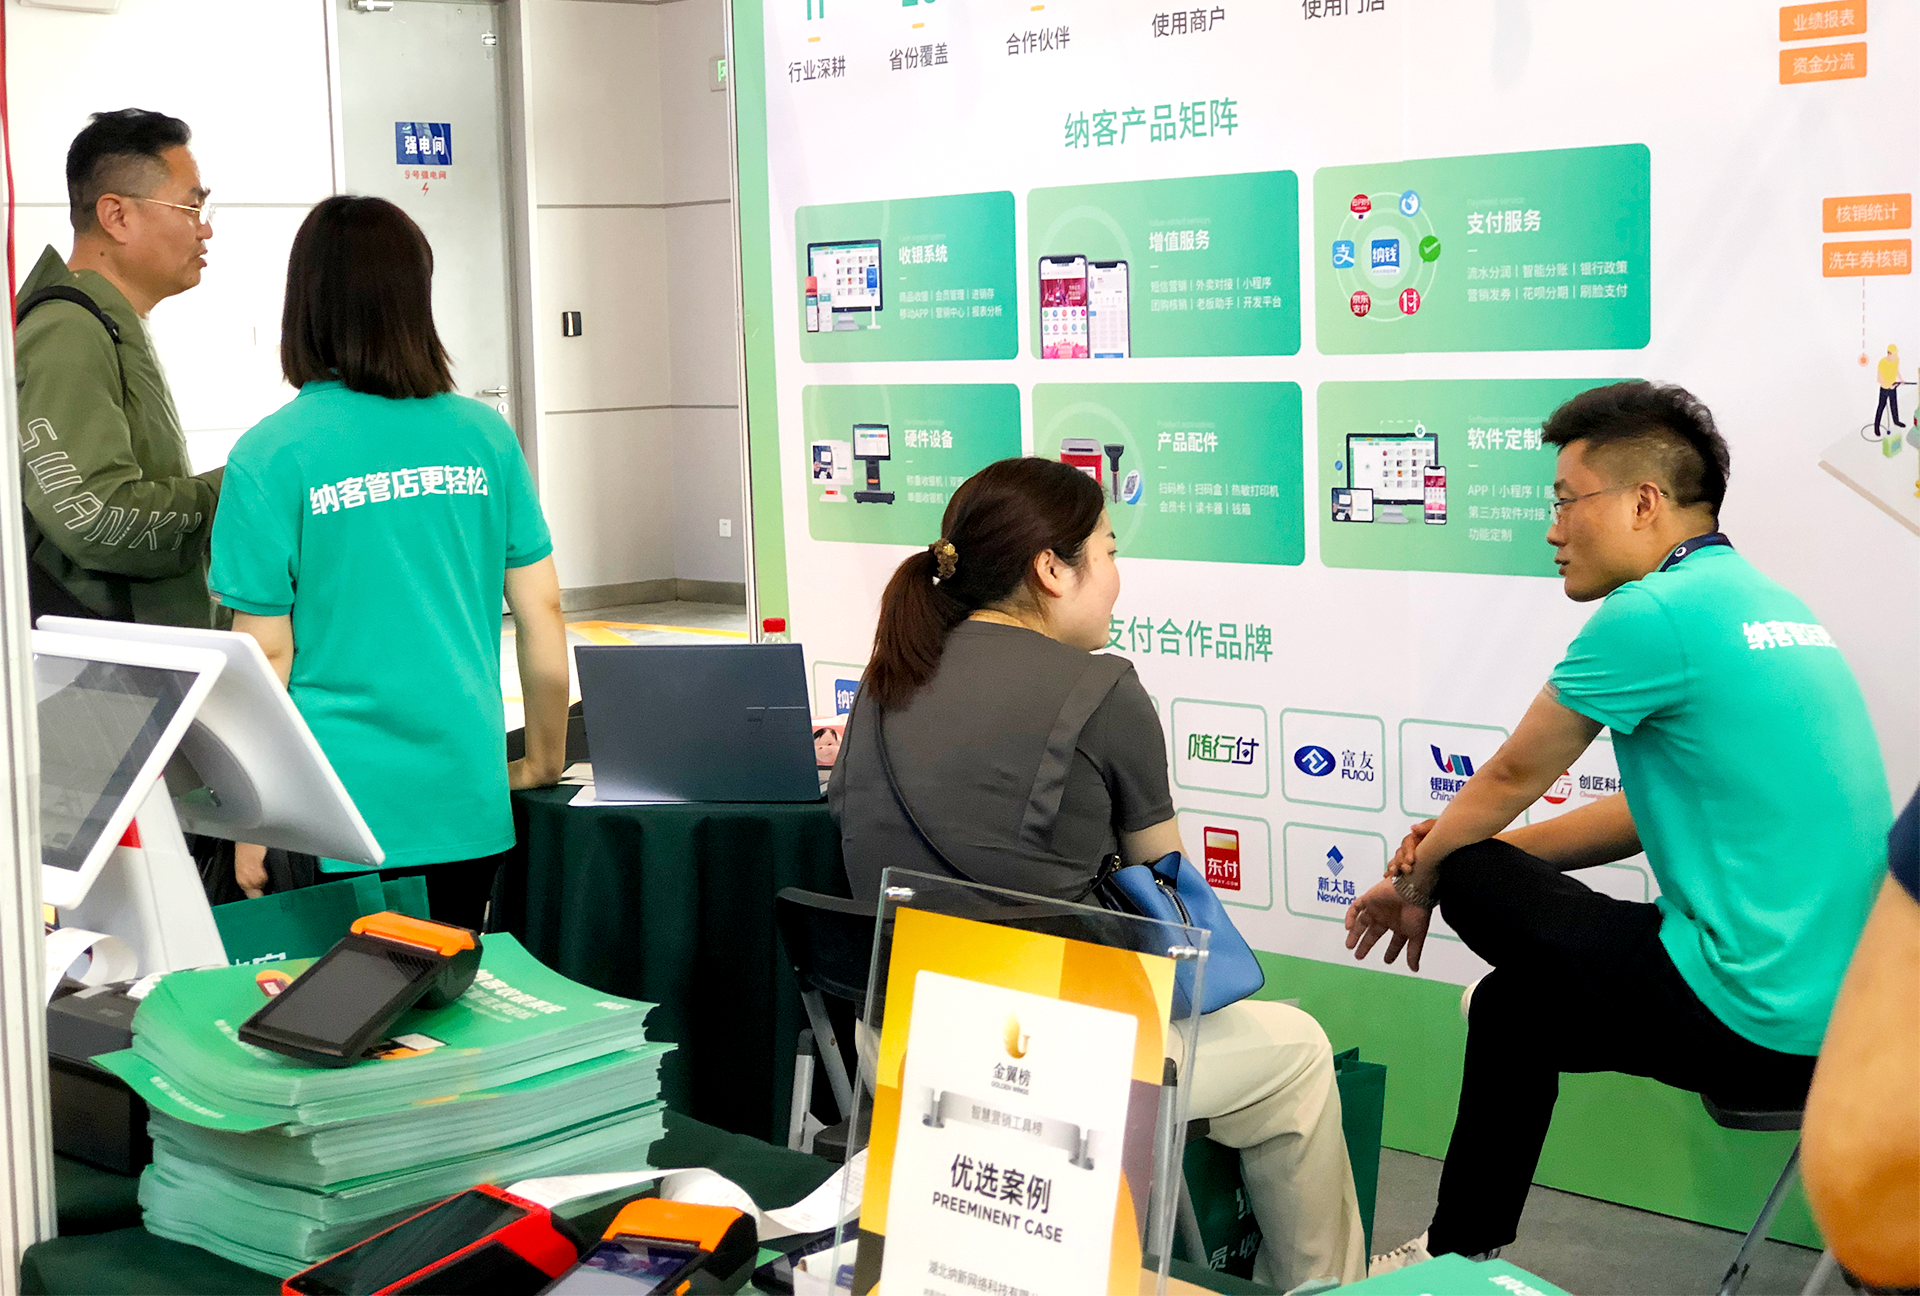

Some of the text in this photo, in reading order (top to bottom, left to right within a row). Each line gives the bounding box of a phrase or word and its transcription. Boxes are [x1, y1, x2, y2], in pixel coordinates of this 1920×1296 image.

[1151, 6, 1226, 38] 使用商户
[1793, 8, 1855, 32] 业绩报表
[1006, 25, 1071, 56] 合作伙伴
[889, 42, 949, 71] 省份覆盖
[1792, 52, 1855, 76] 资金分流
[788, 55, 846, 83] 行业深耕
[1064, 97, 1239, 149] 纳客产品矩阵
[404, 135, 445, 155] 强电间
[1467, 208, 1542, 235] 支付服务
[1836, 203, 1899, 224] 核销统计
[1149, 228, 1210, 252] 增值服务
[899, 244, 948, 265] 收银系统
[1828, 249, 1908, 270] 洗车券核销
[1242, 276, 1272, 290] 小程序
[1243, 295, 1282, 309] 开发平台
[904, 429, 953, 449] 硬件设备
[1157, 431, 1219, 453] 产品配件
[1467, 427, 1543, 451] 软件定制
[309, 464, 489, 515] 纳客管店更轻松
[1231, 484, 1280, 498] 热敏打印机
[1467, 484, 1489, 497] APP
[1499, 484, 1533, 499] 小程序
[1159, 501, 1186, 513] 会员卡
[1468, 505, 1546, 521] 第三方软件对接
[1468, 528, 1513, 542] 功能定制
[1187, 733, 1260, 765] 随行付
[1341, 749, 1374, 770] 富友
[1207, 857, 1238, 879] 东付
[1317, 876, 1355, 896] 新大陆
[993, 1062, 1031, 1087] 金翼榜
[951, 1153, 1052, 1214] 优选案例
[932, 1191, 1063, 1243] PREEMINENT CASE
